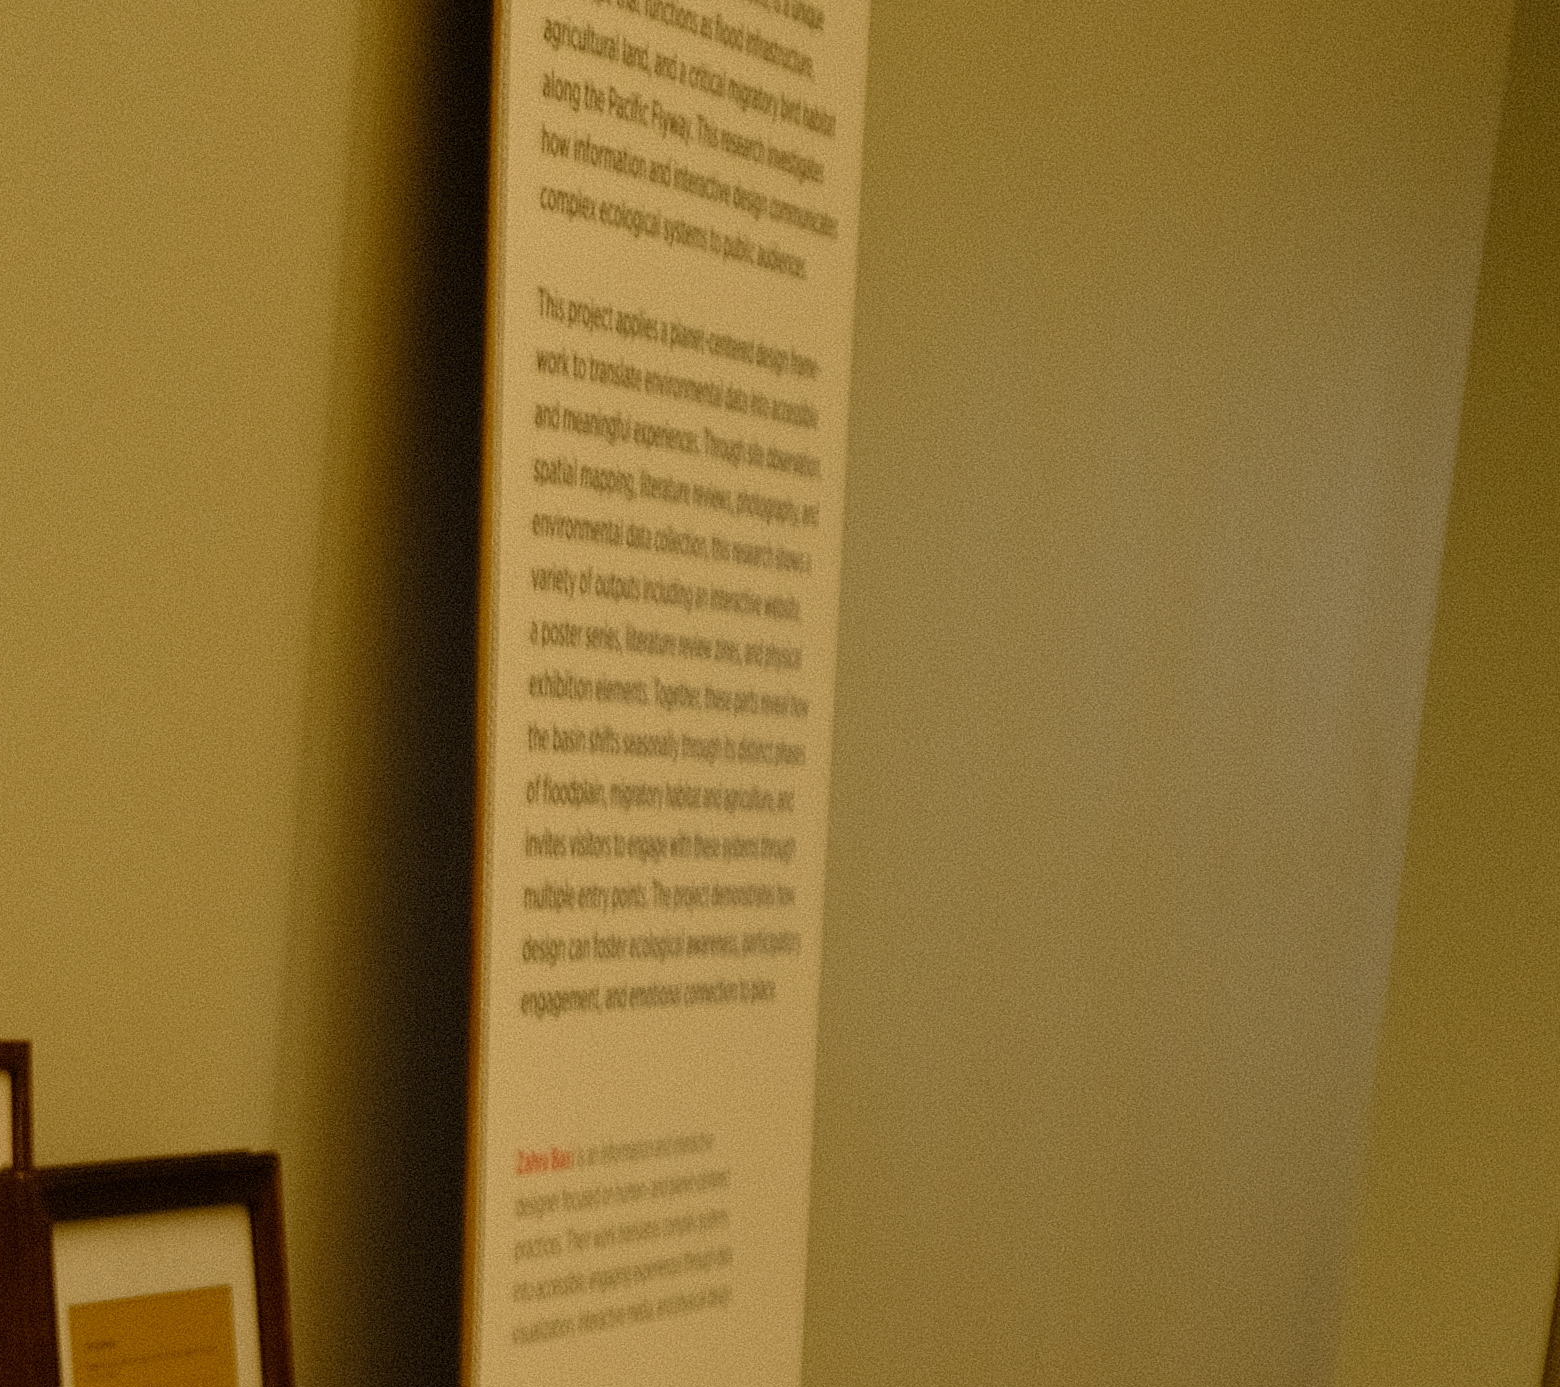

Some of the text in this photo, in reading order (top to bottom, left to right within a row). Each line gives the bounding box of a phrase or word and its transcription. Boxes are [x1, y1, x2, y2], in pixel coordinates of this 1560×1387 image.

[542, 69, 581, 112] along
[584, 81, 604, 119] the
[540, 125, 569, 162] how
[537, 288, 565, 324] This
[536, 344, 569, 380] work
